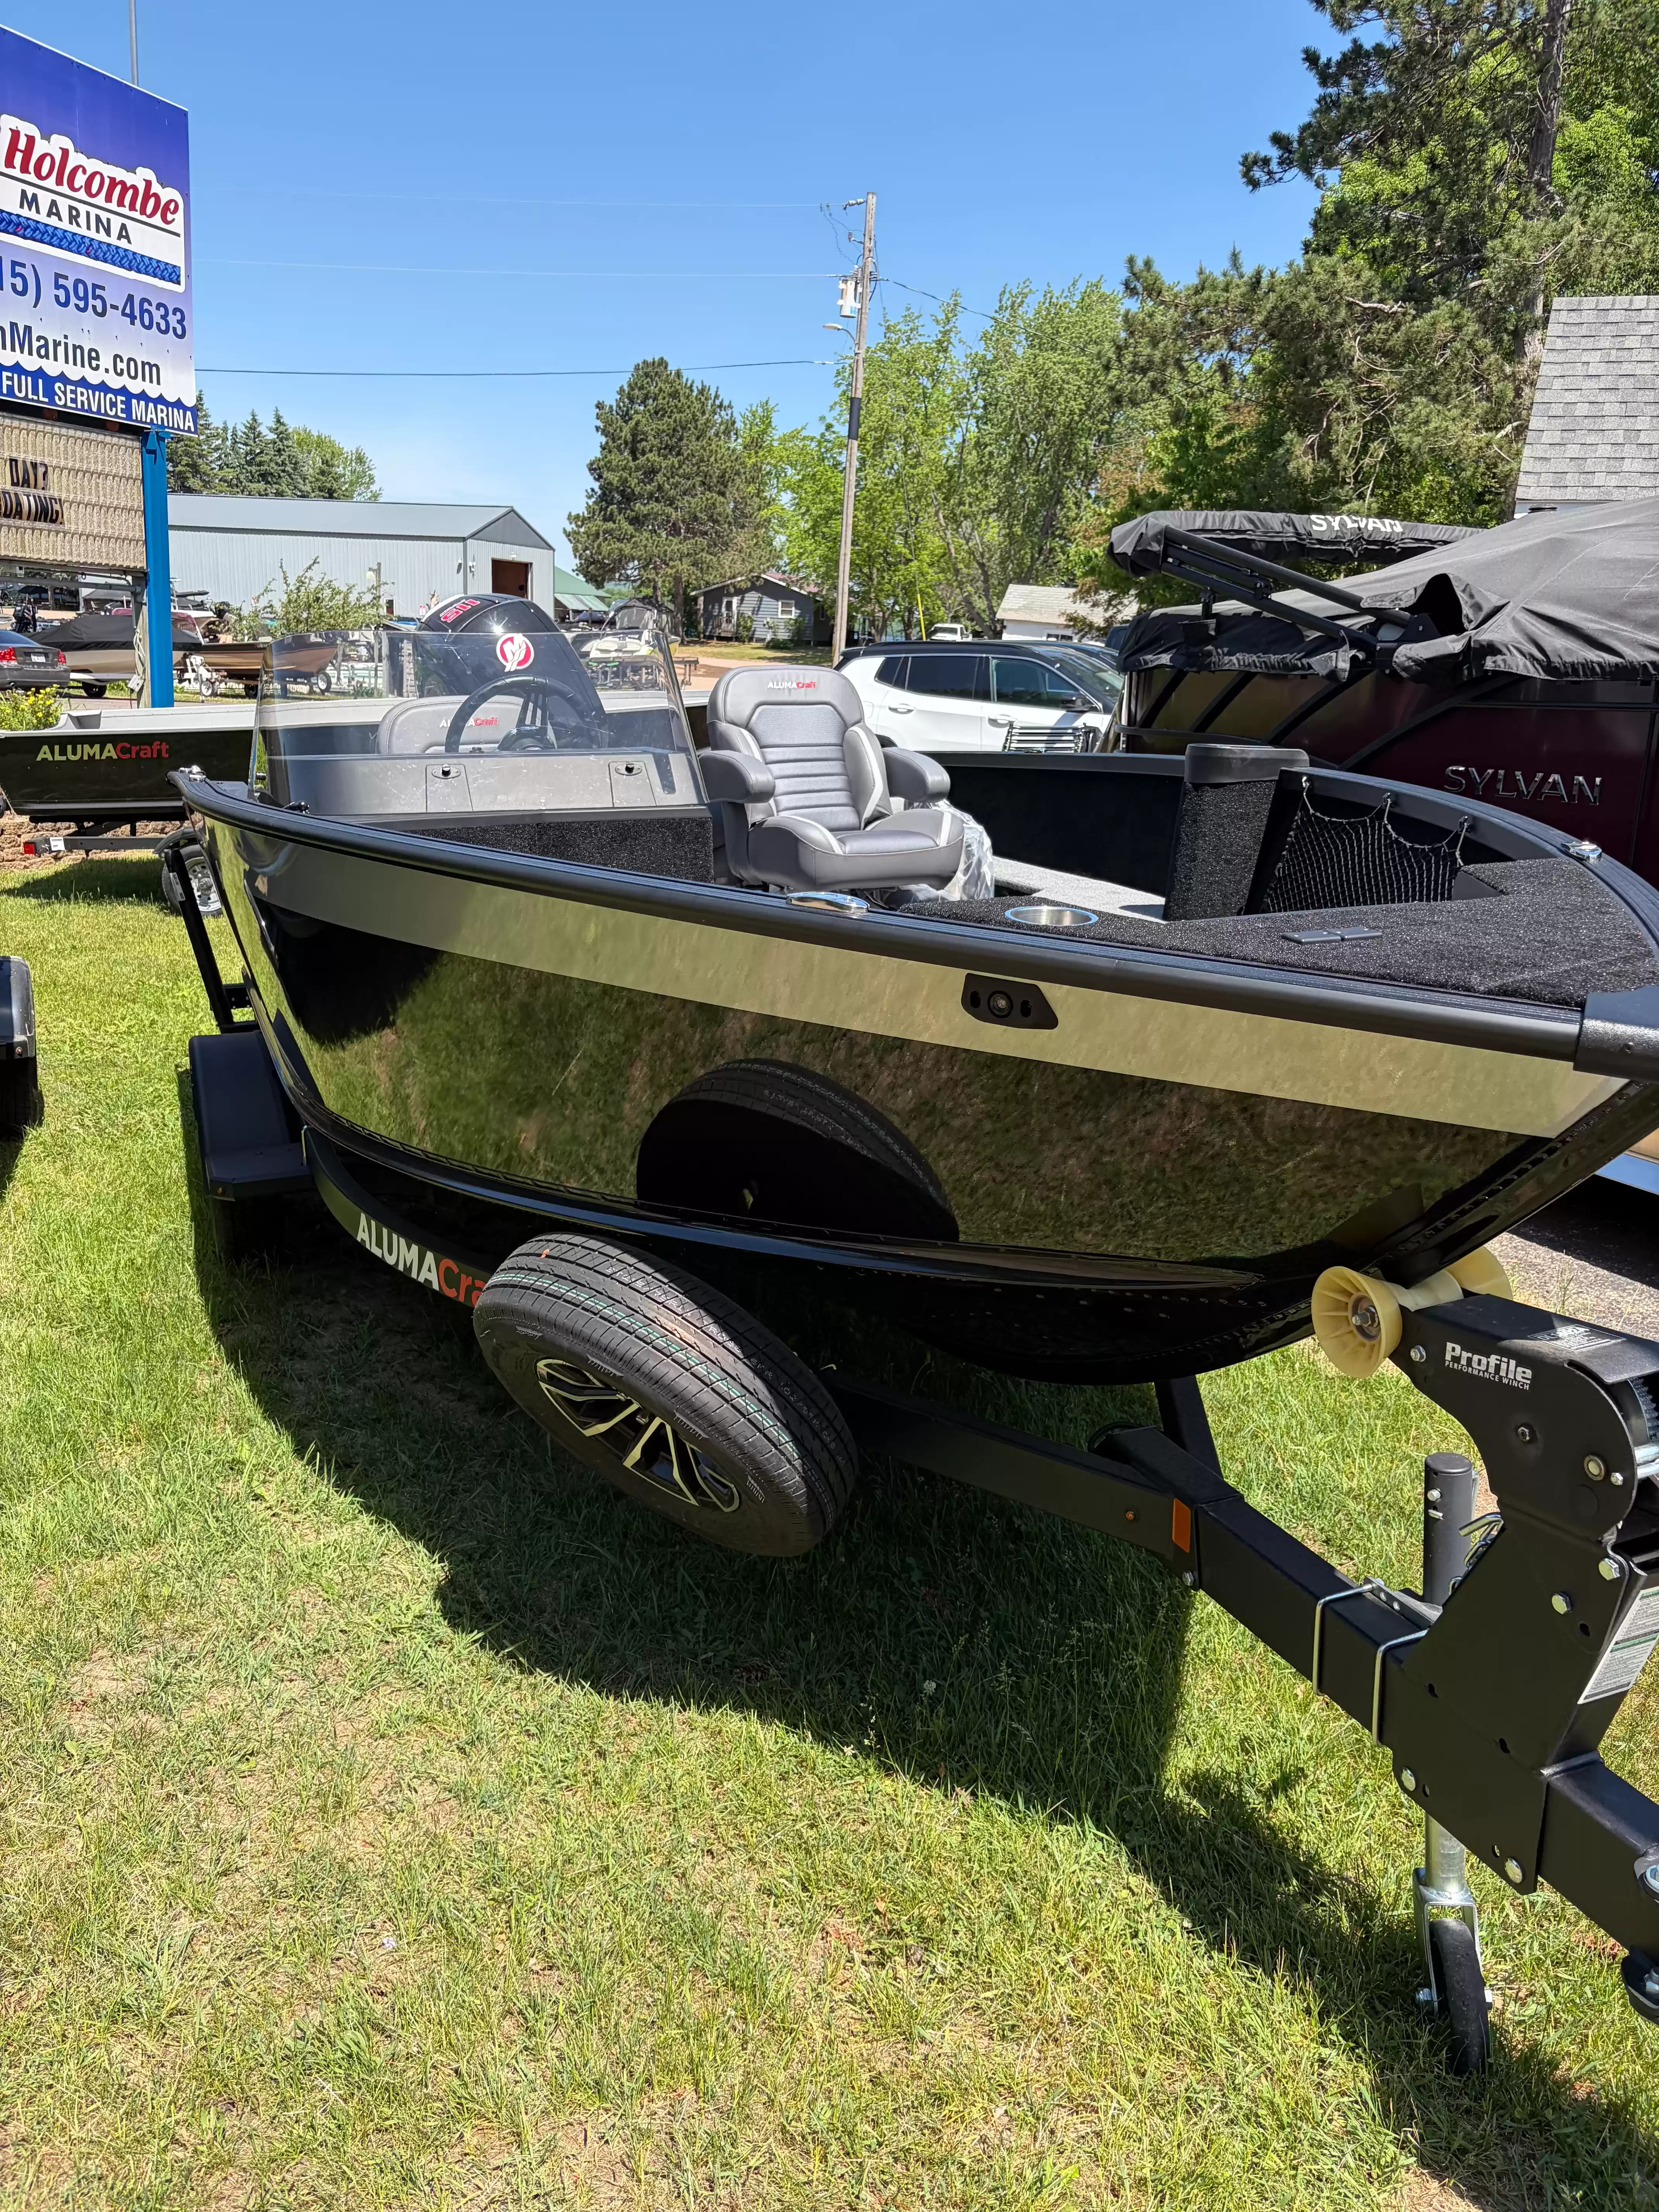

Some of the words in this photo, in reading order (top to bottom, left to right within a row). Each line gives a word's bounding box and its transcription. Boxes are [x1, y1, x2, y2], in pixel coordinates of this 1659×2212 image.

[5, 128, 179, 225] Holcombe
[19, 189, 132, 245] MARINA
[54, 272, 187, 340] 595-4633
[2, 371, 48, 403] FULL
[54, 382, 126, 417] SERVICE
[132, 398, 195, 432] MARINA
[9, 458, 48, 490] DAY?
[1310, 514, 1403, 532] SYLVAN
[767, 681, 816, 689] ALUMACraft
[439, 716, 498, 728] ALACraft
[36, 741, 169, 761] ALUMACraft
[1444, 765, 1602, 806] SYLVAN
[357, 1212, 486, 1307] ALUMACra
[1445, 1342, 1532, 1384] Profile
[1445, 1361, 1500, 1381] PERFORMANCE
[1502, 1377, 1529, 1390] WINCH
